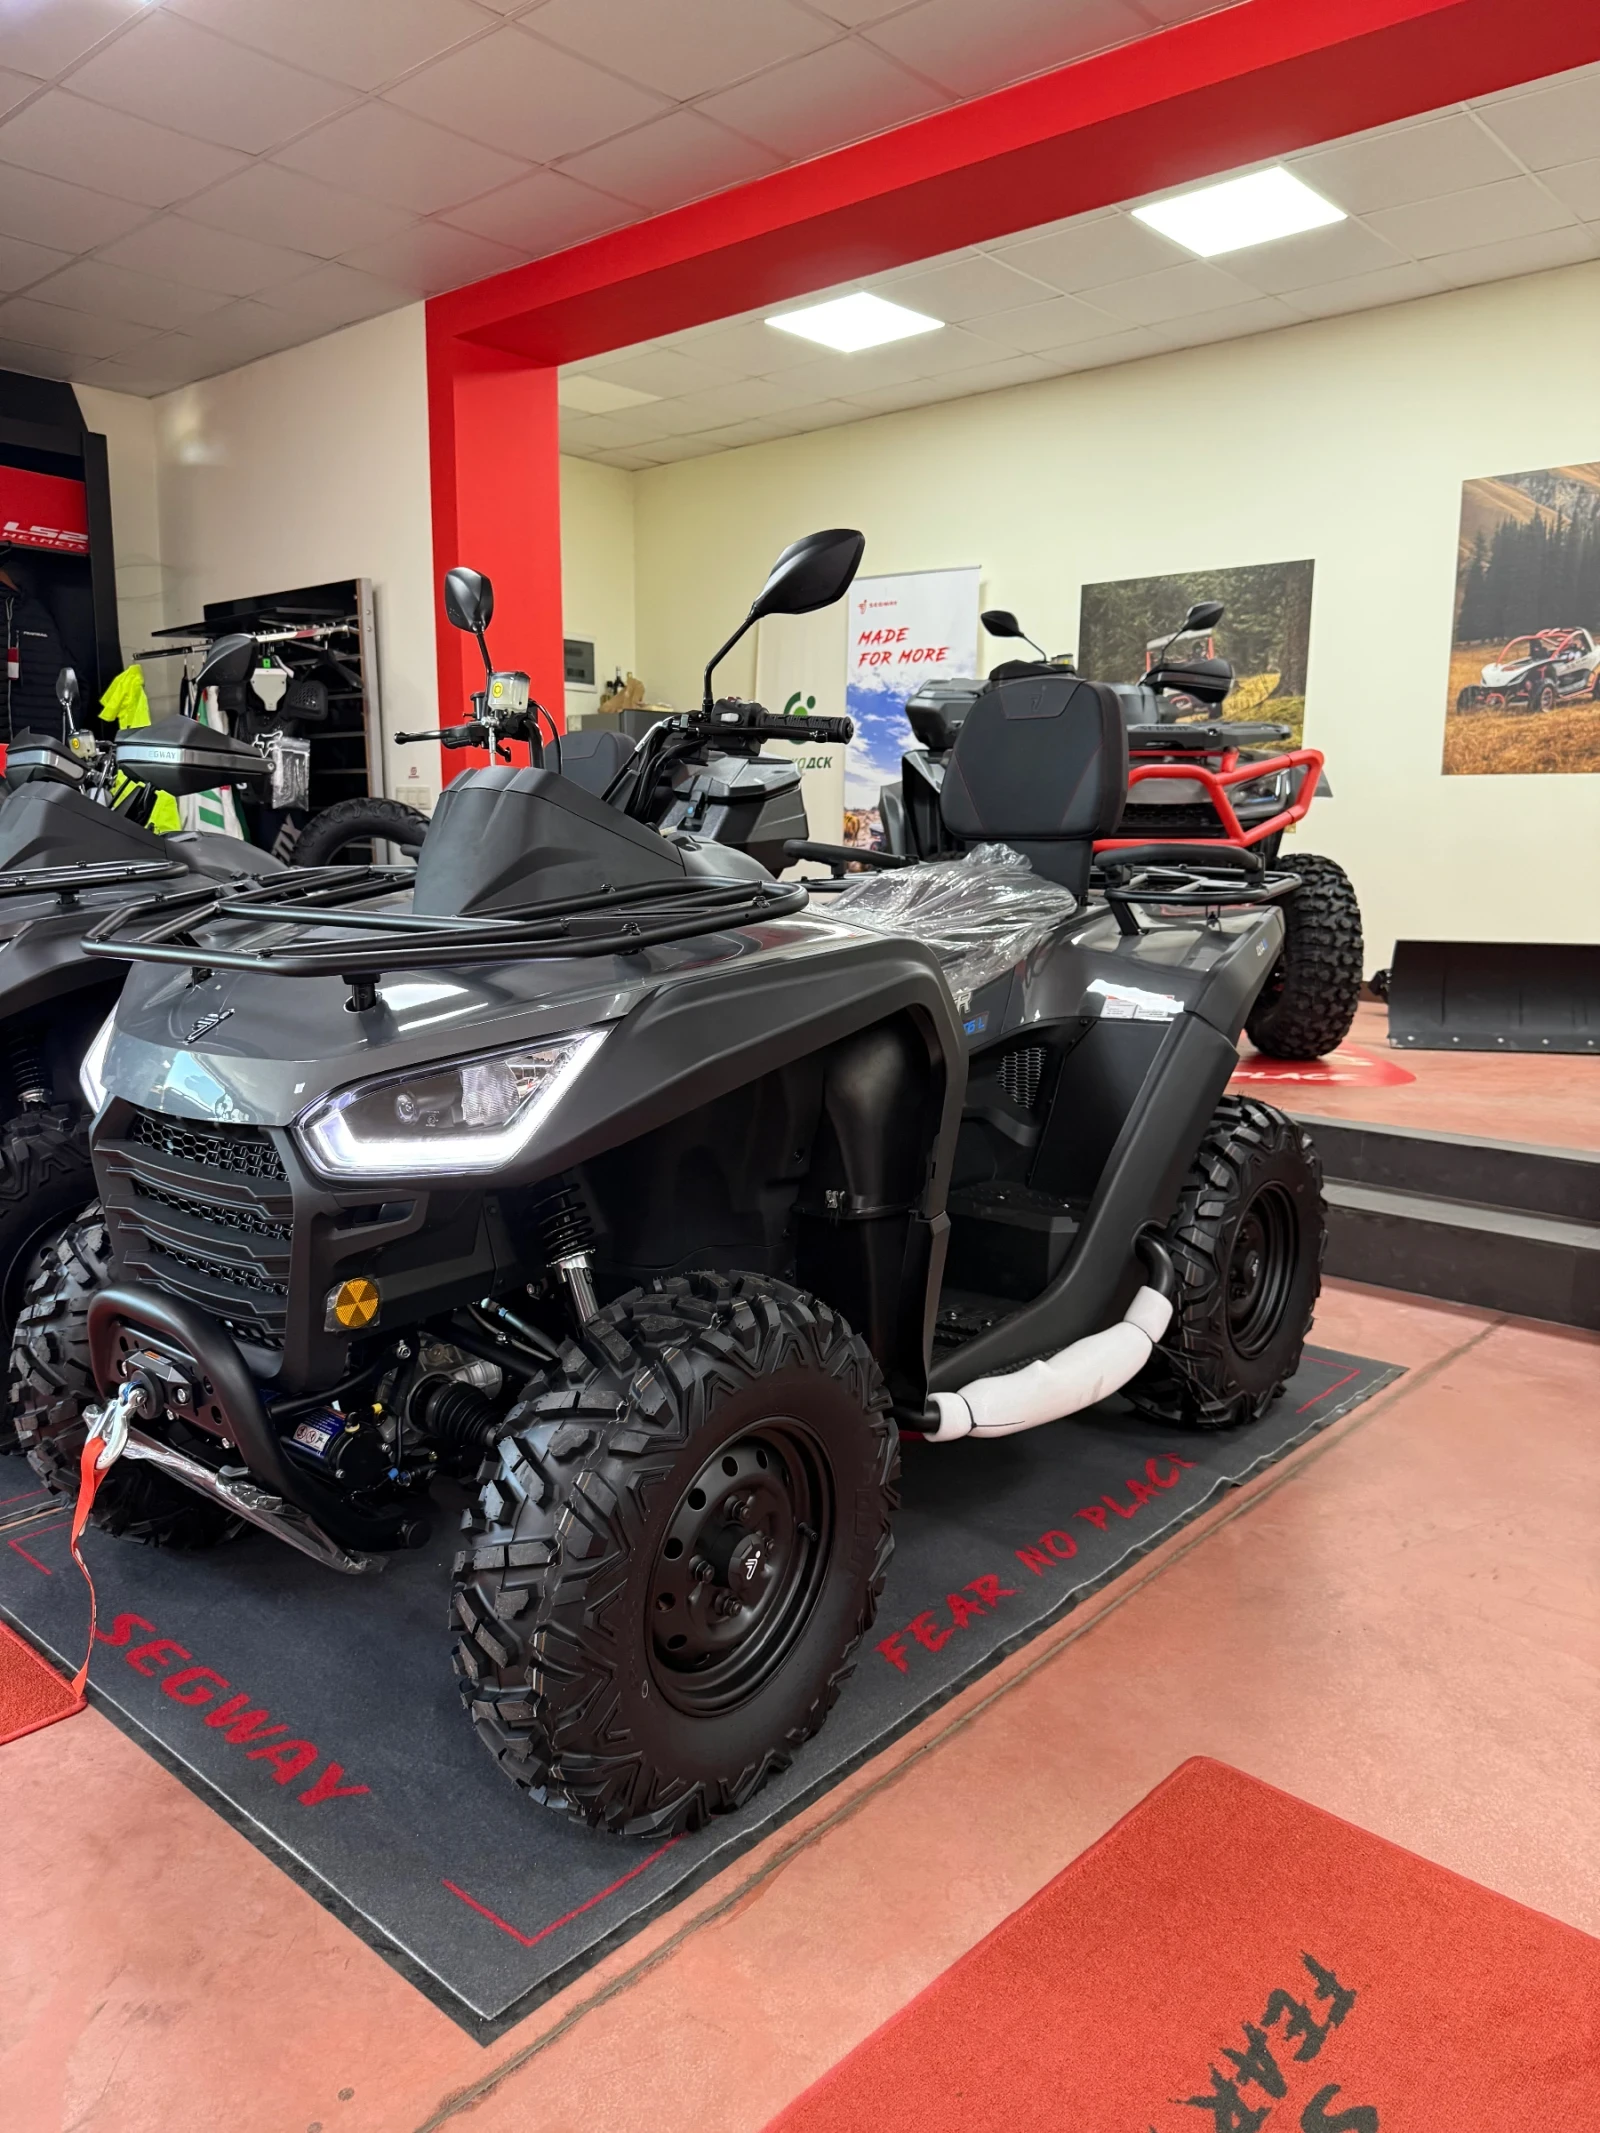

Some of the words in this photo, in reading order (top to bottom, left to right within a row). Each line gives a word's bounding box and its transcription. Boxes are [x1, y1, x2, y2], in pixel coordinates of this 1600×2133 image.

[2, 531, 87, 550] HELMETS
[3, 521, 89, 544] LS2
[857, 627, 910, 646] MADE
[858, 651, 893, 668] FOR
[897, 646, 950, 665] MORE
[147, 750, 177, 760] EGWAY
[792, 756, 833, 770] ОДСК
[875, 1574, 1026, 1675] FEAR
[1014, 1529, 1078, 1577] NO
[89, 1613, 371, 1806] SEGWAY
